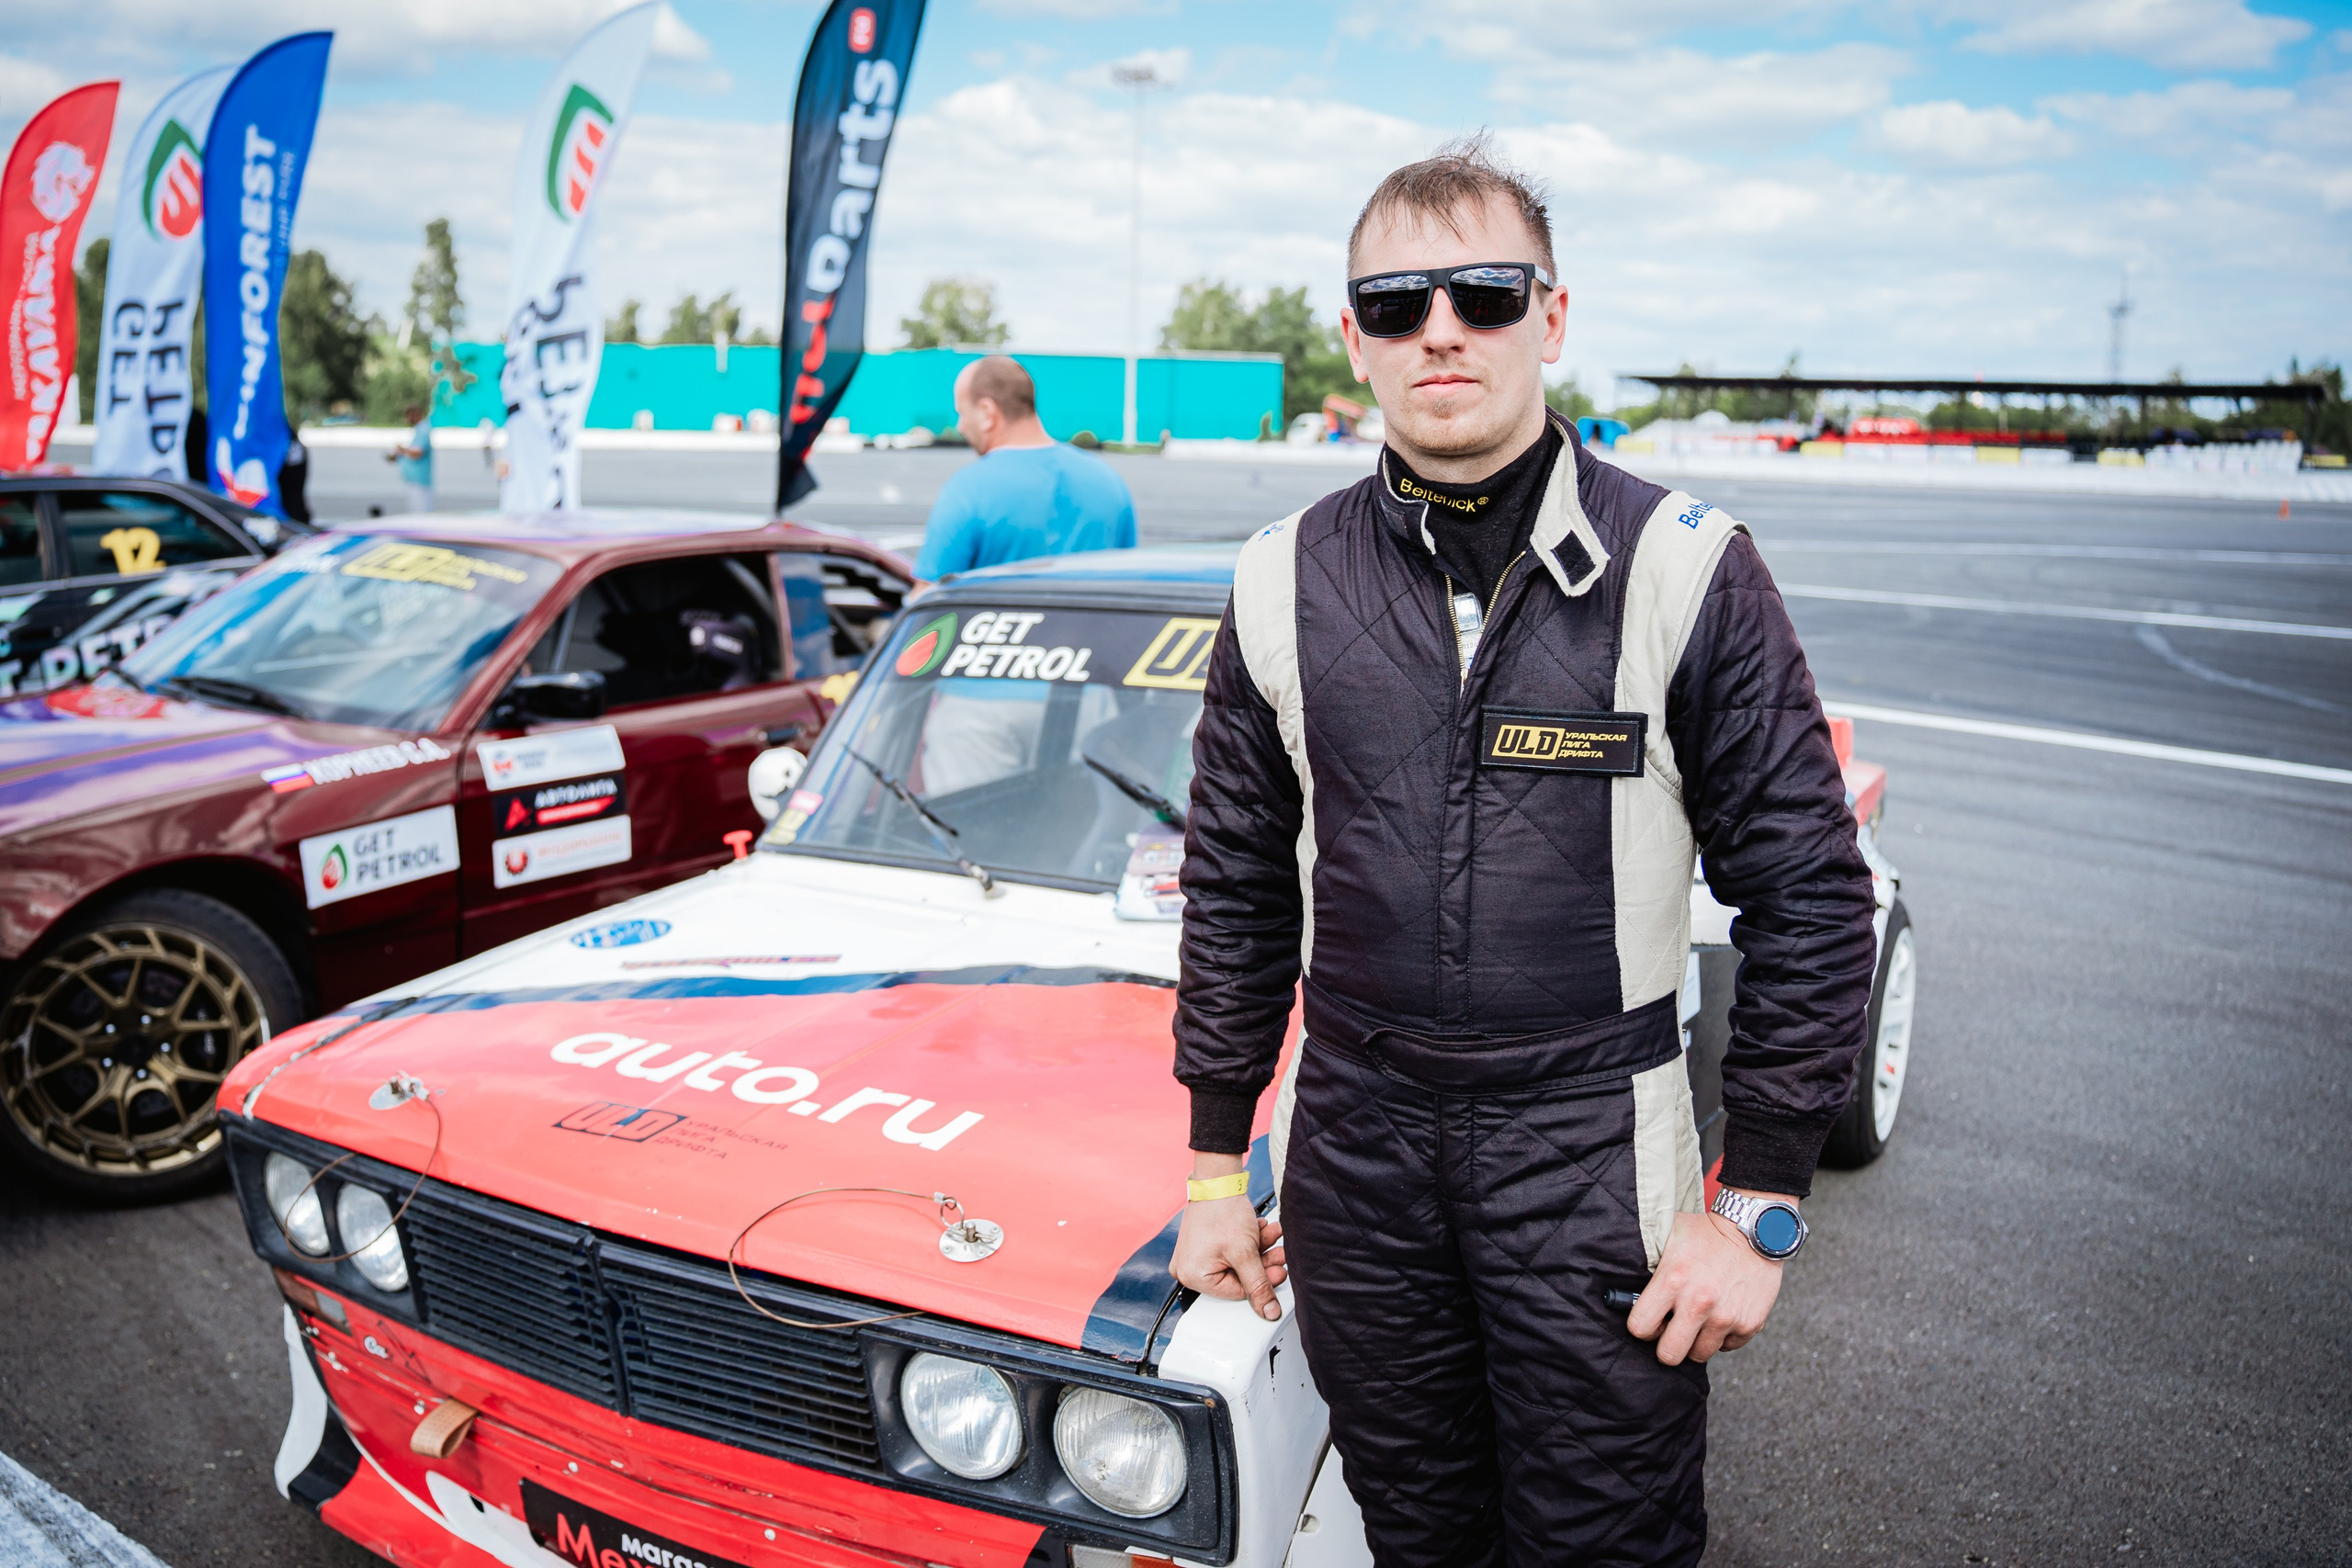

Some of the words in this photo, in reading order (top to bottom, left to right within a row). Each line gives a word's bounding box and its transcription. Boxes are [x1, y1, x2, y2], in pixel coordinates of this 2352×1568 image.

[99, 526, 167, 578] 12
[961, 611, 1045, 645] GET
[940, 644, 1092, 682] PETROL
[1494, 726, 1563, 759] ULD
[1561, 740, 1590, 749] ЛИГА
[1565, 732, 1628, 742] УРАЛЬСКАЯ
[1558, 749, 1604, 759] ДРИФТА
[353, 829, 394, 858] GET
[356, 844, 441, 885] PETROL
[550, 1032, 985, 1151] auto.ru
